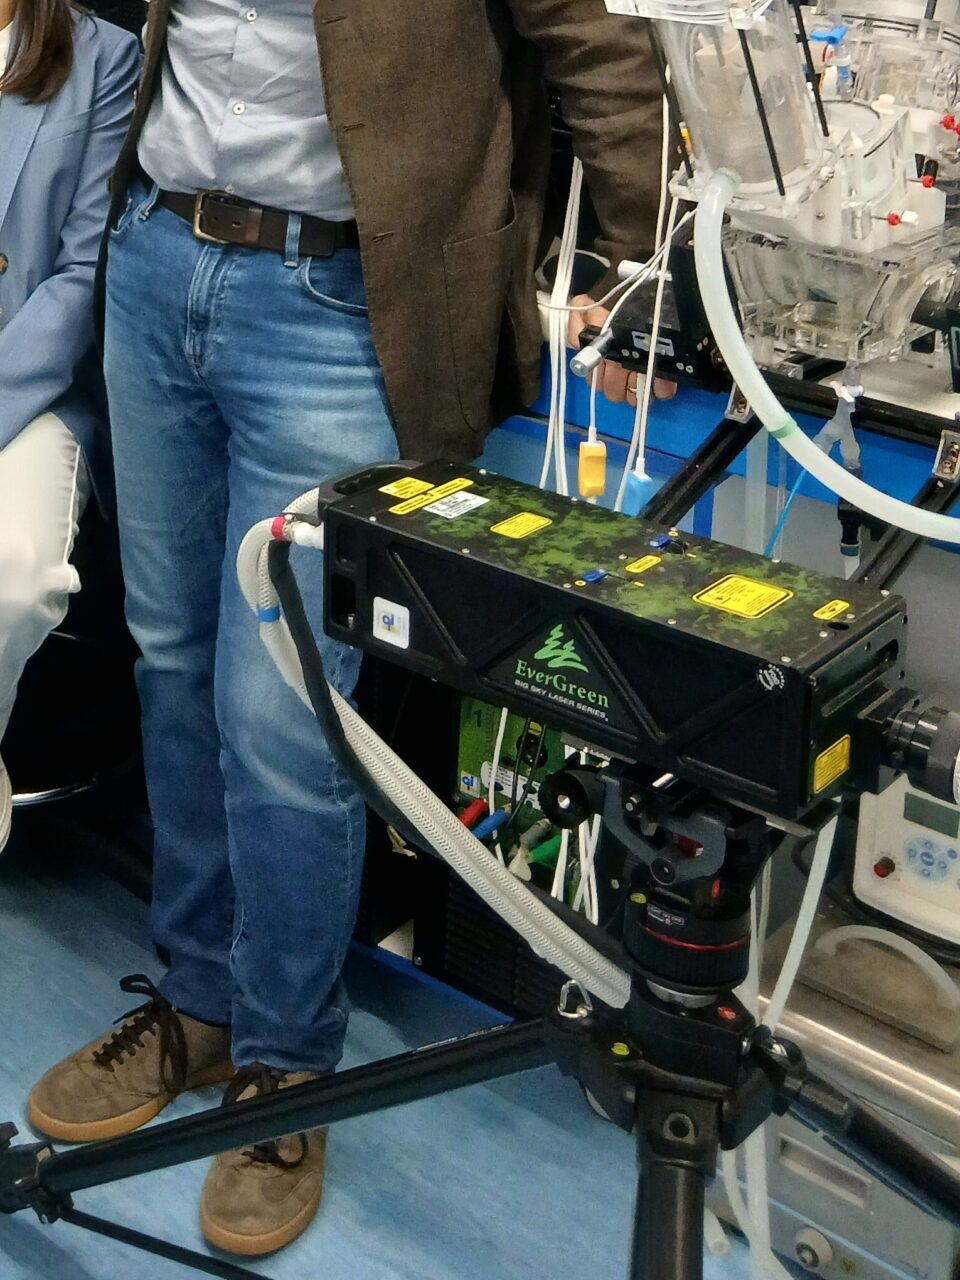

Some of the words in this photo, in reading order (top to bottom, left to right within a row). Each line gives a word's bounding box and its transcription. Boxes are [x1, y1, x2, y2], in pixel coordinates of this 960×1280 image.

[514, 679, 529, 689] BIG
[530, 684, 547, 695] SKY
[548, 692, 576, 707] LASER
[515, 659, 609, 708] EverGreen
